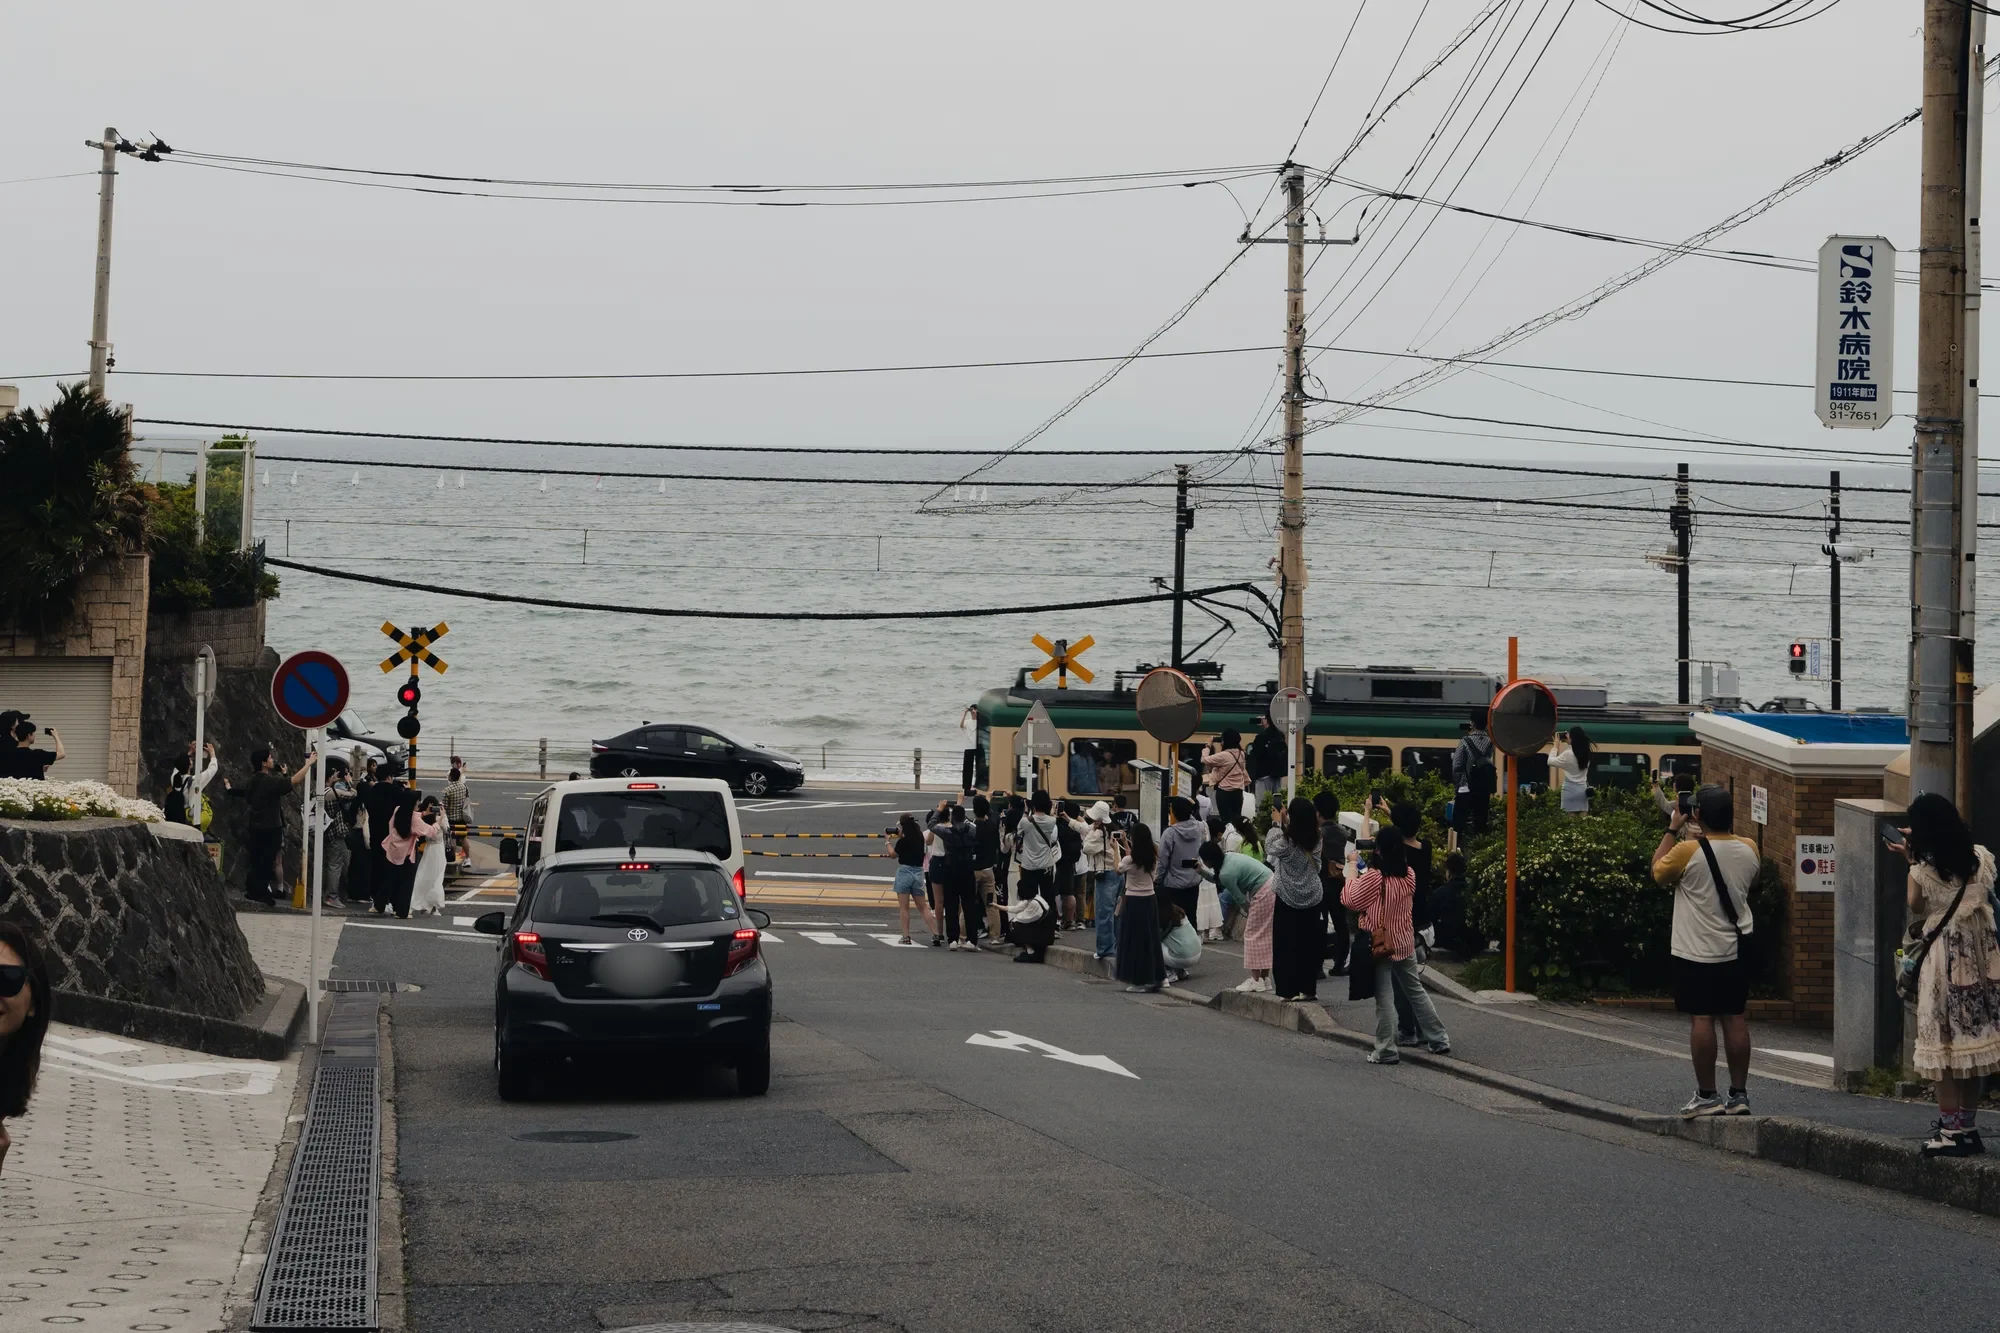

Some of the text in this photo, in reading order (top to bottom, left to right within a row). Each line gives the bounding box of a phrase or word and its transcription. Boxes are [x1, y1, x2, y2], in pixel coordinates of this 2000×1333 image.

[1838, 280, 1872, 380] 鈴木病院
[1832, 386, 1876, 398] 1911年創立
[1830, 402, 1857, 411] 0467
[1830, 411, 1877, 420] 31-7651
